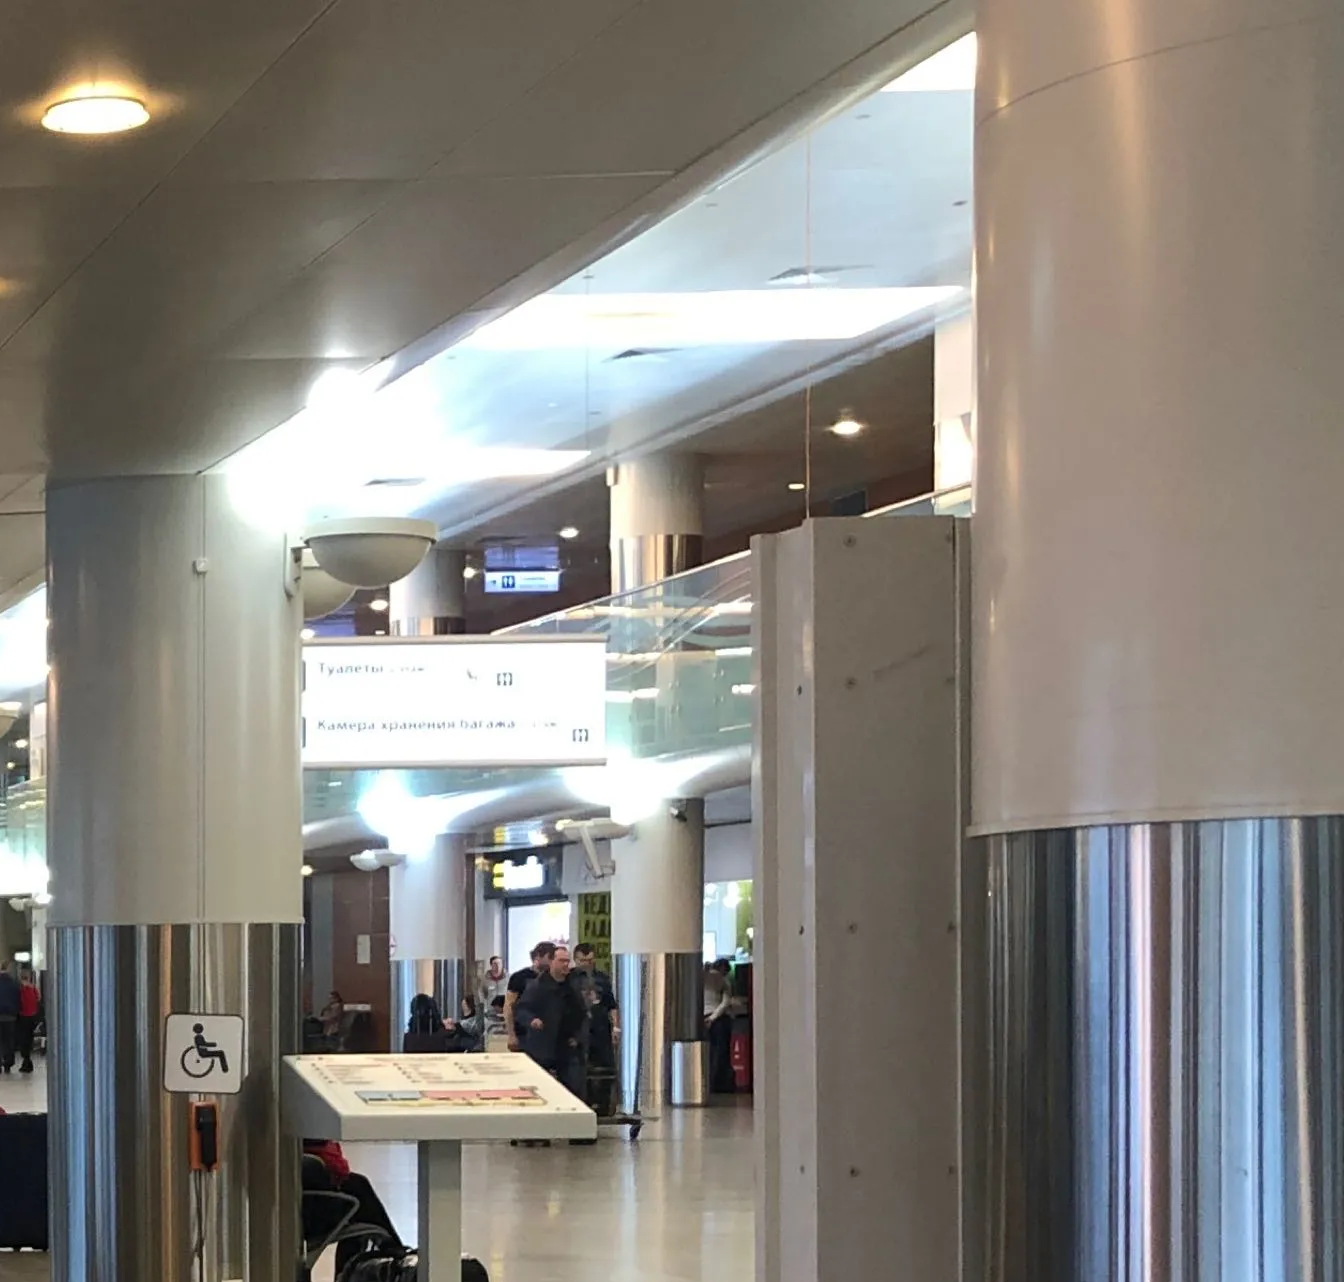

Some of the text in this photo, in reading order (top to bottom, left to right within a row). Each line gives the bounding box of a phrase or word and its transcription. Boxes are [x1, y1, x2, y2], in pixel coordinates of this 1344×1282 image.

[318, 662, 384, 679] Туалеты
[317, 719, 375, 733] Камера
[381, 720, 456, 733] хранения
